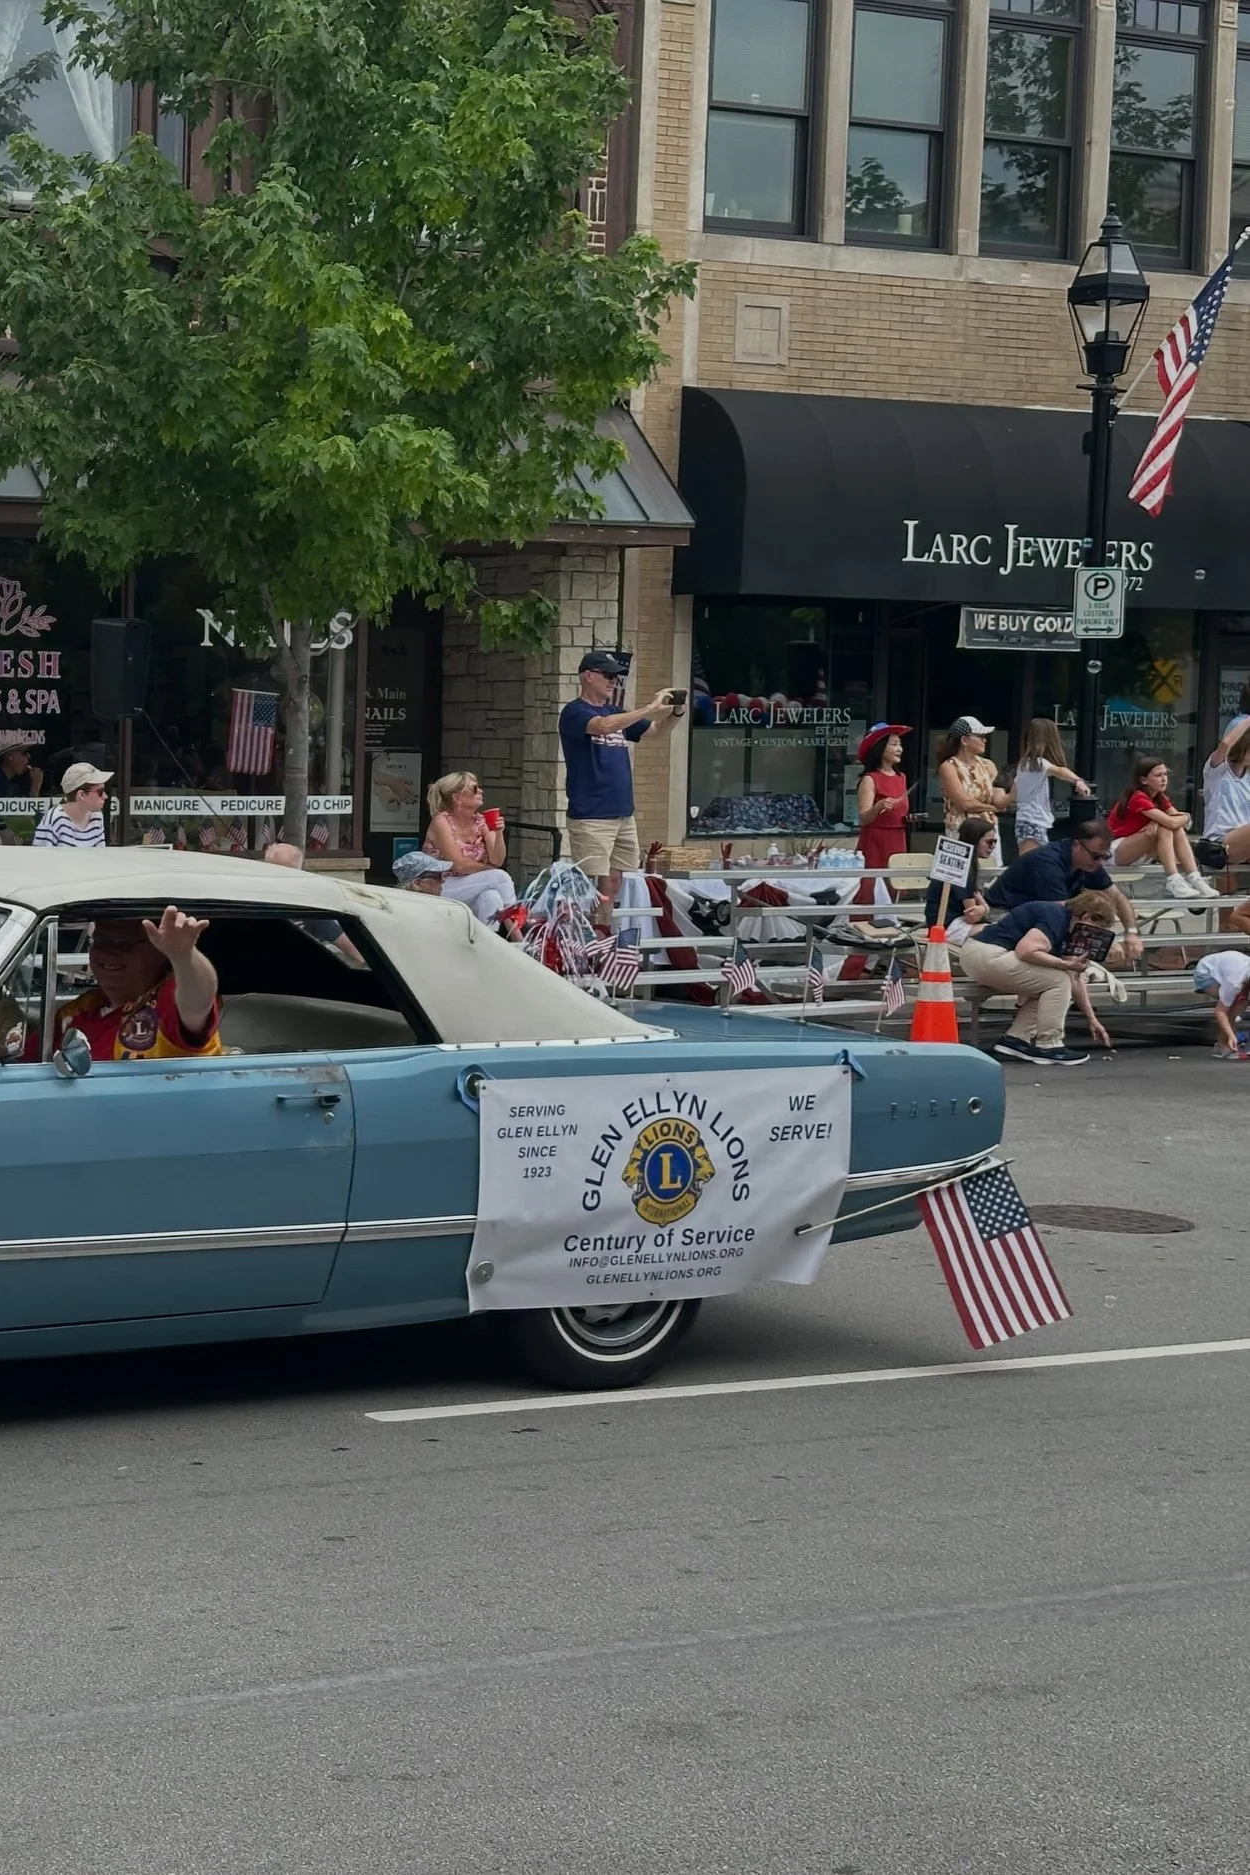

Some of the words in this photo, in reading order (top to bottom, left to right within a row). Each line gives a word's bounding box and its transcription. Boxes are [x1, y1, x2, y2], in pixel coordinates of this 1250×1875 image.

[901, 519, 992, 566] LARC
[999, 524, 1154, 575] JEWEERS
[1093, 577, 1109, 596] P
[1124, 576, 1143, 591] 72
[973, 613, 996, 631] WE
[999, 614, 1032, 632] BUY
[1034, 615, 1073, 633] GOLD
[6, 688, 21, 714] &
[25, 689, 61, 714] SPA
[376, 687, 407, 700] Main
[1221, 694, 1240, 705] YOU
[364, 707, 407, 721] NAILS
[713, 701, 761, 725] LARC
[766, 701, 851, 729] JEWELERS
[1052, 704, 1078, 726] LA
[1099, 704, 1178, 732] JEWELERS
[833, 726, 850, 735] 1972
[713, 738, 753, 747] VINTAGE
[759, 738, 796, 747] CUSTOM
[803, 738, 825, 747] RARE
[827, 738, 851, 747] GEMS
[134, 801, 199, 812] MANICURE
[221, 800, 282, 811] PEDICURE
[323, 799, 351, 810] CHIP
[939, 853, 966, 870] SEATING
[509, 1104, 566, 1118] SERVING
[789, 1094, 817, 1111] WE
[497, 1126, 533, 1139] GLEN
[537, 1124, 578, 1137] ELLYN
[643, 1122, 696, 1147] LIONS
[769, 1122, 833, 1142] SERVE!
[518, 1146, 557, 1158] SINCE
[582, 1124, 623, 1212] GLEN
[622, 1090, 707, 1128] ELLYN
[709, 1111, 750, 1202] LIONS
[523, 1166, 552, 1179] 1923
[658, 1152, 682, 1190] L
[563, 1234, 646, 1253] Century
[653, 1227, 675, 1248] of
[681, 1225, 755, 1246] Service
[569, 1247, 745, 1269] INFO@GLENELLYNLIONS.ORG
[586, 1266, 723, 1285] GLENELLYNLIONS.ORG
